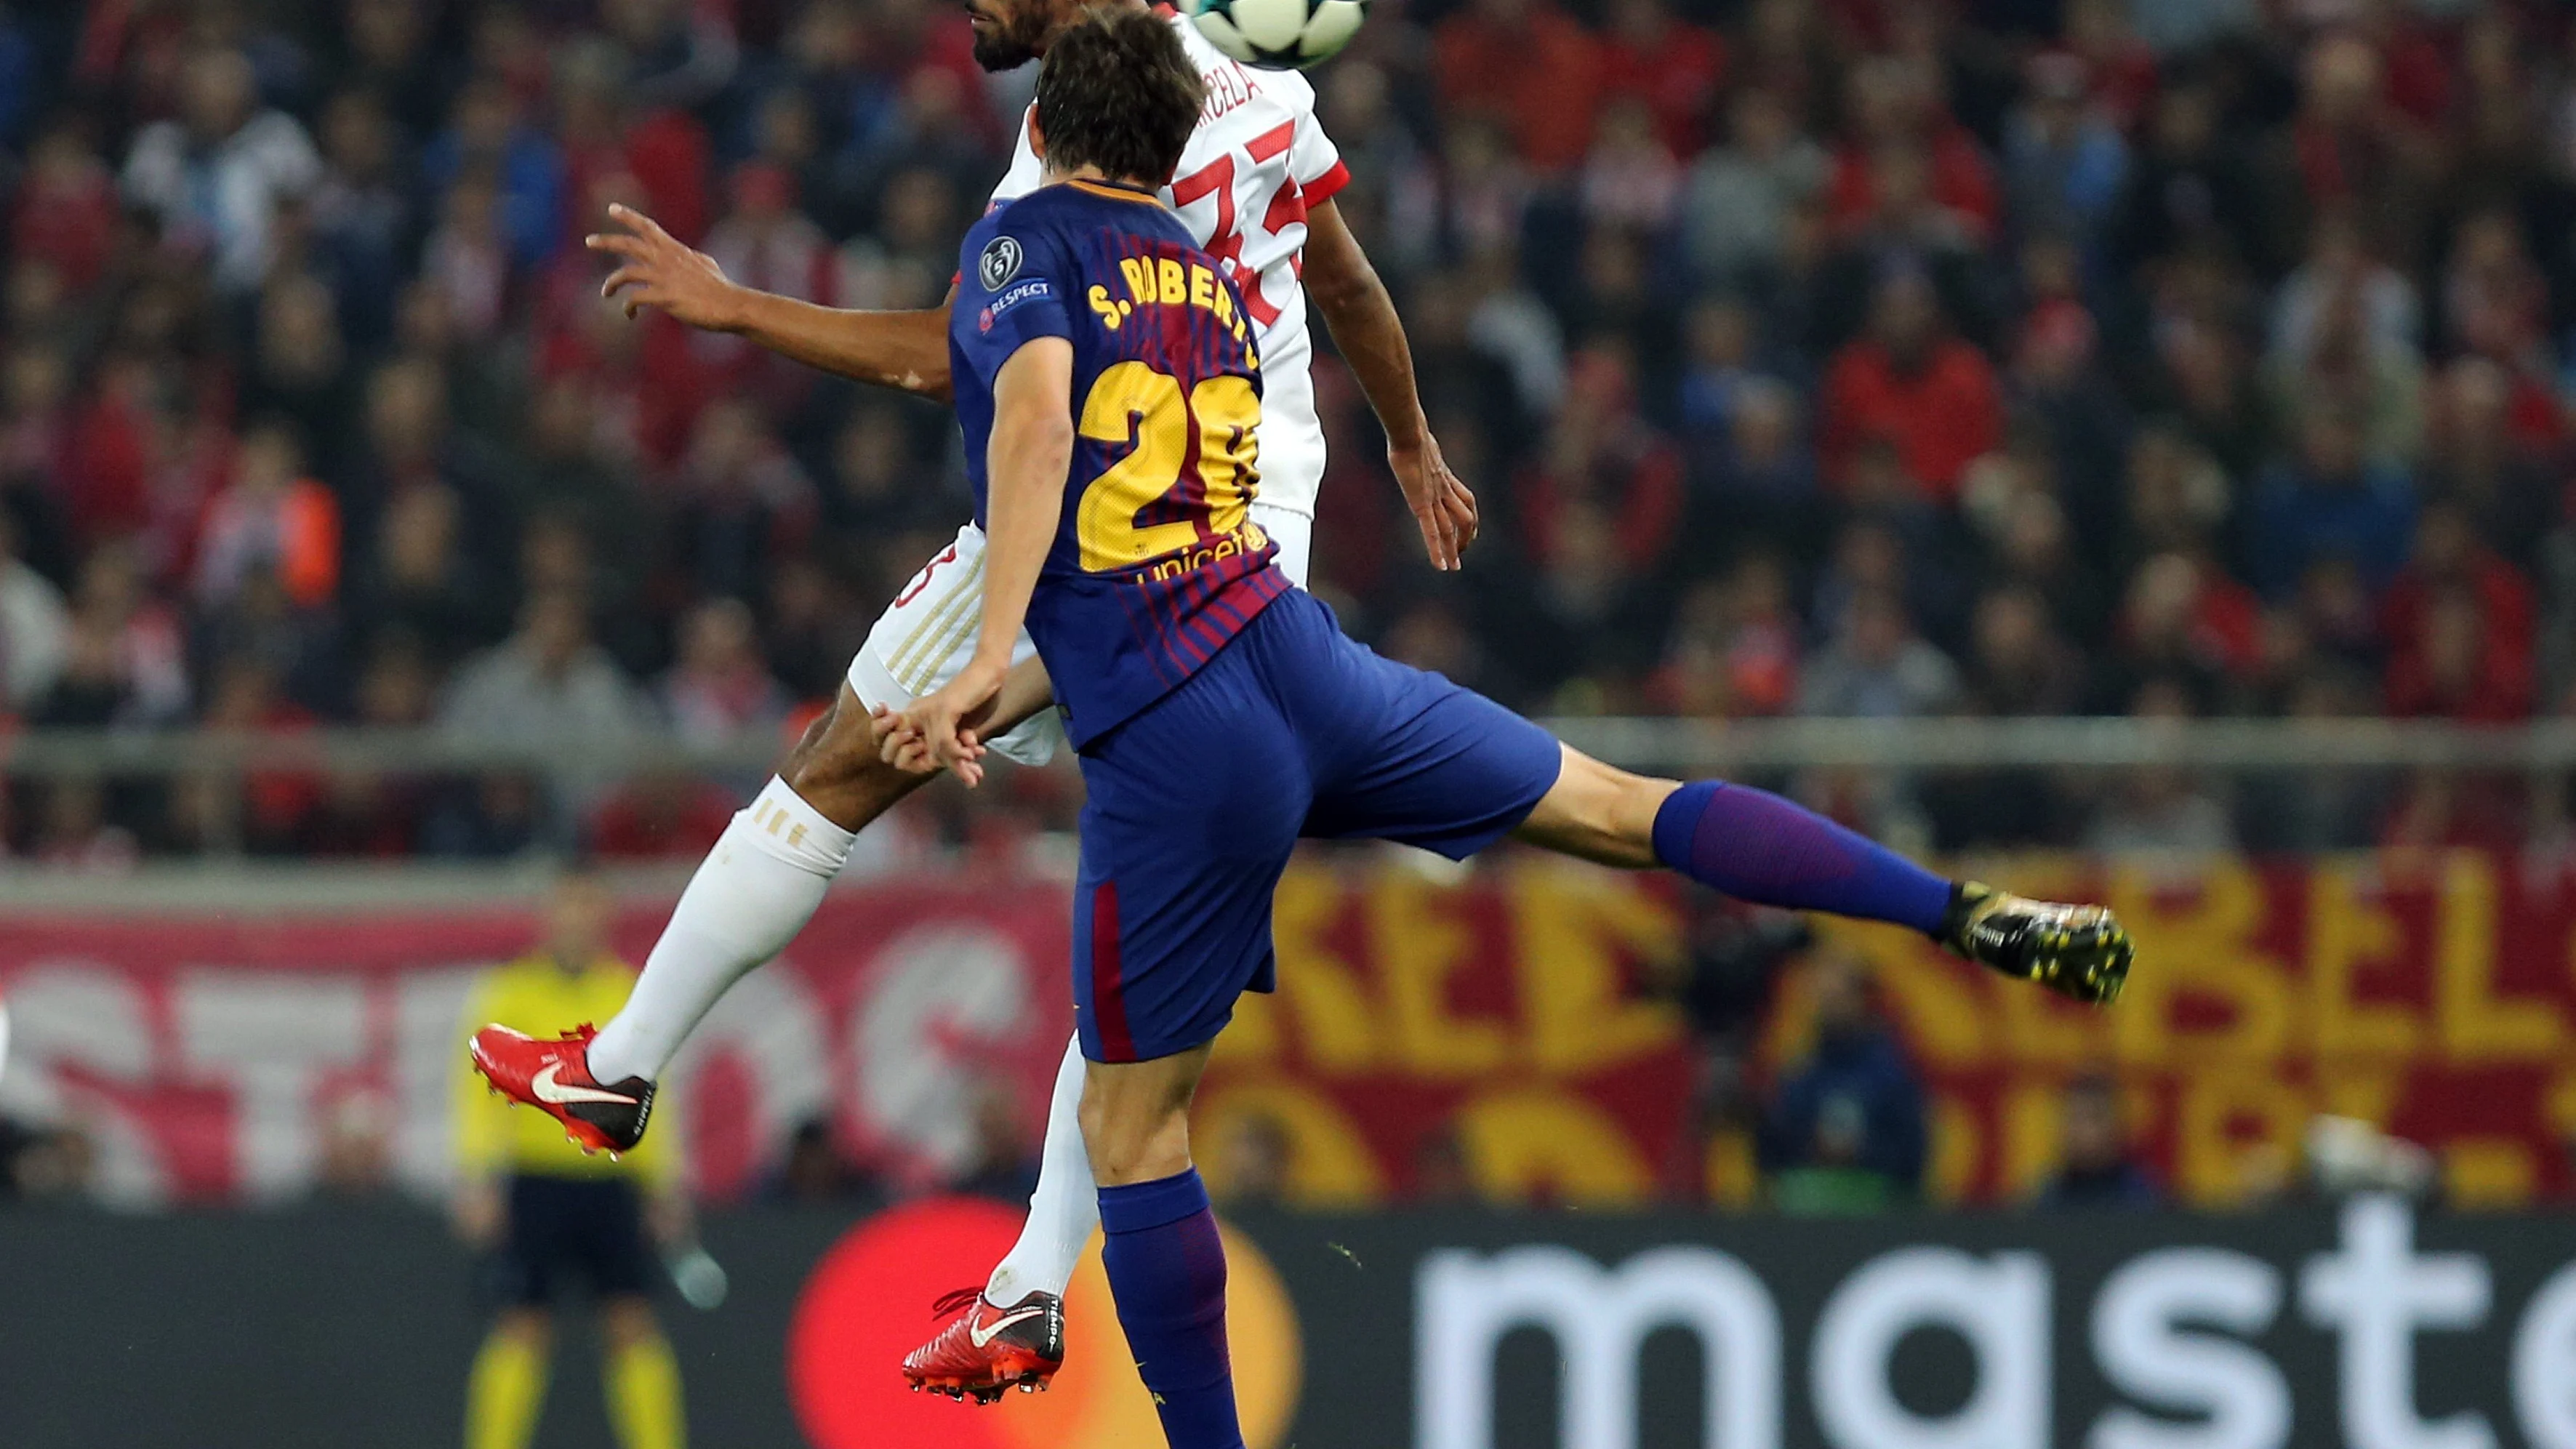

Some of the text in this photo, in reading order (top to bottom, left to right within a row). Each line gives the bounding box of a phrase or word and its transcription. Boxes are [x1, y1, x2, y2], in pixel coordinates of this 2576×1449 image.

[991, 283, 1048, 315] RESPECT
[1088, 284, 1132, 330] S.
[1048, 1299, 1059, 1347] TIEMPO
[1413, 1192, 2576, 1449] mast
